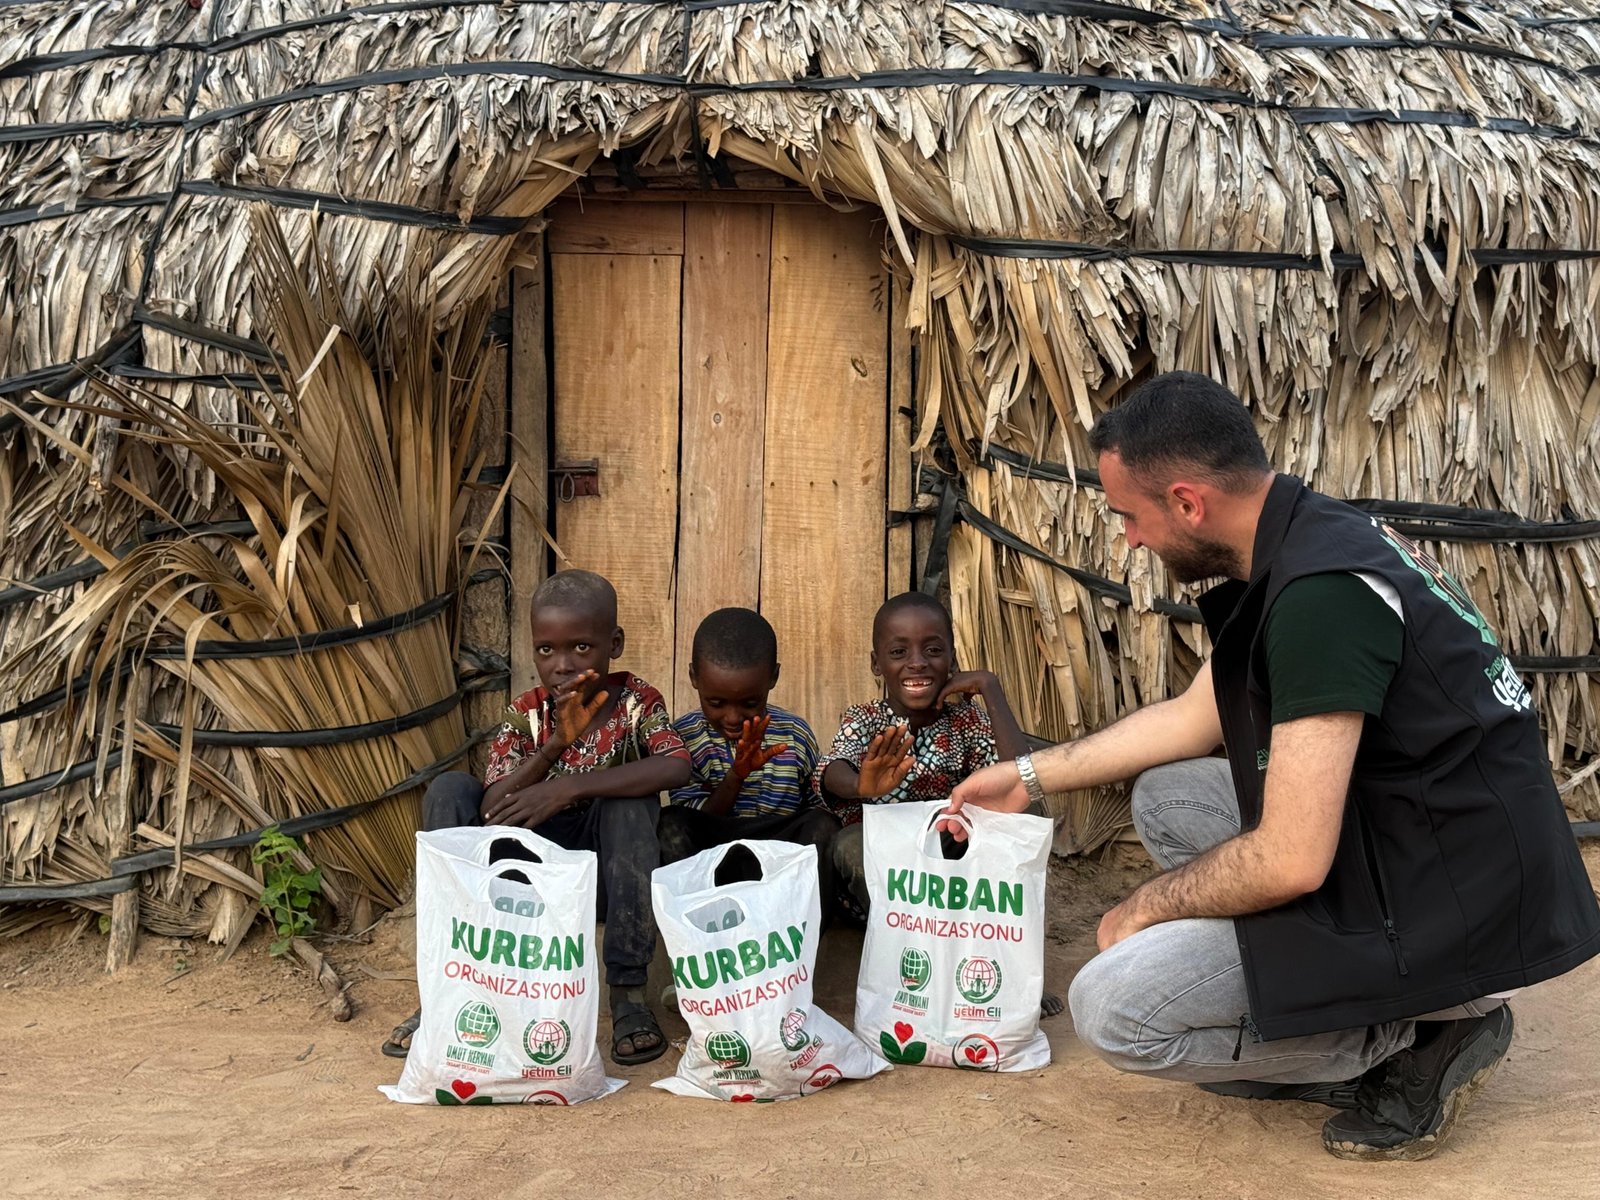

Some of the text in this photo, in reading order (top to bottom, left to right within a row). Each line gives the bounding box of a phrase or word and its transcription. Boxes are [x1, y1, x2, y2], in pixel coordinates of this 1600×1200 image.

[887, 868, 1023, 917] KURBAN
[451, 916, 584, 971] KURBAN
[886, 911, 1023, 943] ORGANİZASYONU
[670, 921, 807, 990] KURBAN
[444, 960, 585, 1000] ORGANİZASYONU
[986, 1006, 1001, 1018] Eli
[521, 1064, 572, 1079] yetim Eli
